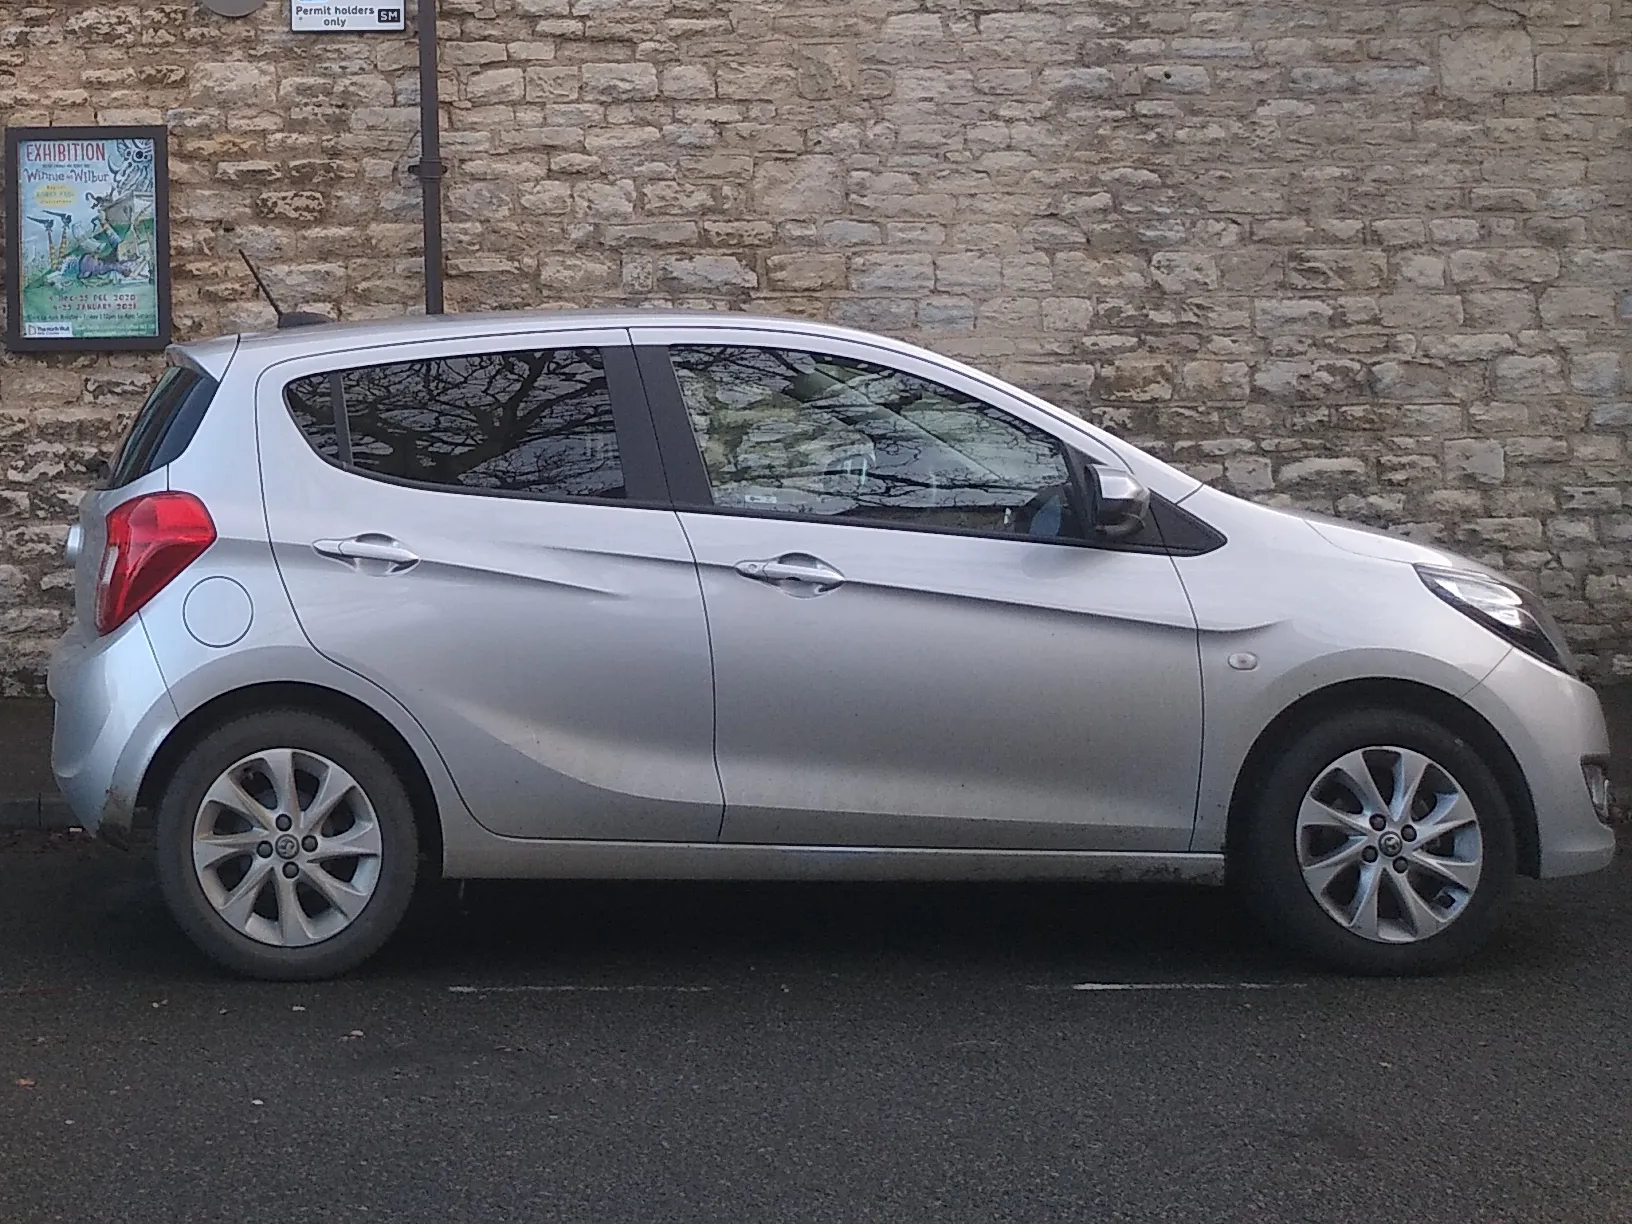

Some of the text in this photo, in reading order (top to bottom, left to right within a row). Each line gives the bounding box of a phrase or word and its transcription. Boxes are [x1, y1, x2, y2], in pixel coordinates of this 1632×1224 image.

[295, 5, 375, 15] Permit holders
[380, 11, 398, 21] SM
[323, 17, 347, 27] only
[26, 142, 105, 162] EXHIBITION
[23, 168, 66, 183] Winnie
[70, 168, 110, 183] Wilbur
